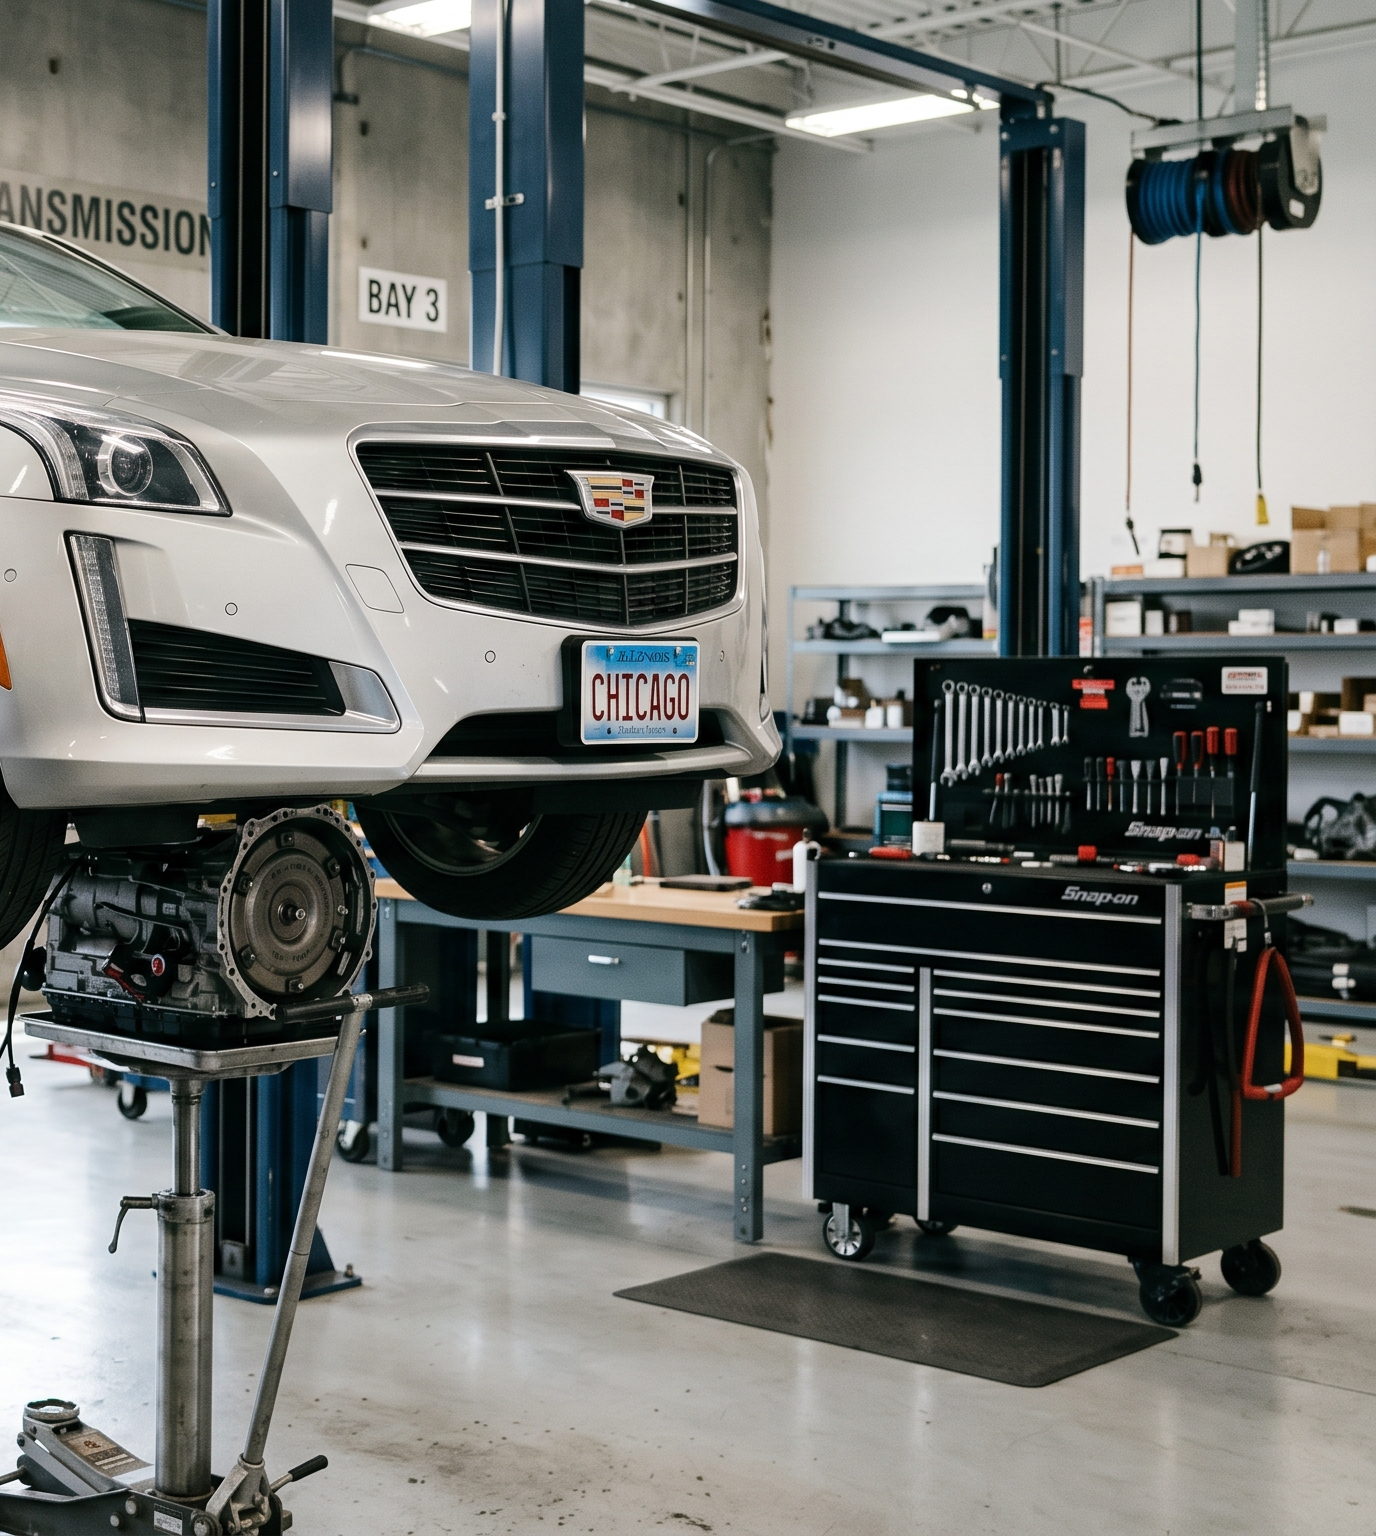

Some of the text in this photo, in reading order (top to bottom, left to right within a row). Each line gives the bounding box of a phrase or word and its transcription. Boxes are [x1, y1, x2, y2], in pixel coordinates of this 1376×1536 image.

[369, 279, 439, 322] BAY 3
[591, 673, 690, 721] CHICAGO
[1124, 821, 1202, 842] Snap-on
[1061, 885, 1139, 906] Snap-on
